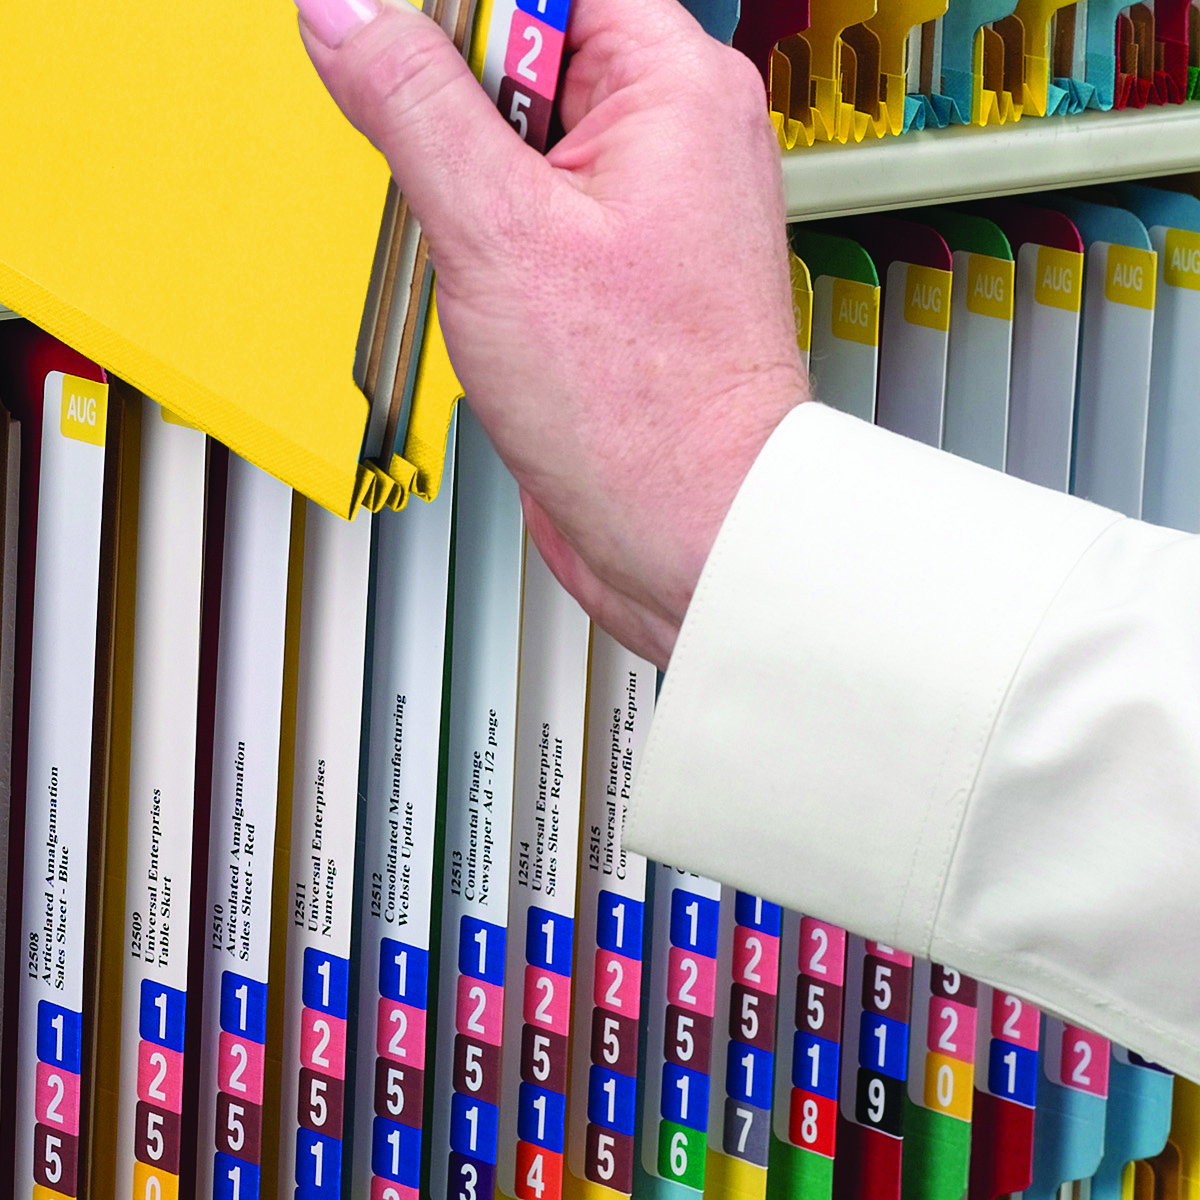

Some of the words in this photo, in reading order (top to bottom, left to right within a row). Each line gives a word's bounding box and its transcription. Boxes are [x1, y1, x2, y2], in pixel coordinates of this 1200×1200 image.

[911, 285, 942, 313] AUG
[973, 273, 1005, 303] AUG
[1042, 265, 1073, 295] AUG
[839, 298, 869, 327] AUG
[388, 693, 407, 816] Manufacturing
[535, 722, 552, 814] Enterprises
[549, 737, 565, 800] Reprint
[311, 758, 327, 852] Enterprises
[400, 800, 415, 860] Update
[547, 803, 560, 854] Sheet-
[147, 787, 163, 883] Enterprises
[531, 815, 546, 892] Universal
[383, 818, 400, 924] Consolidated
[517, 840, 531, 888] 12514
[544, 856, 558, 898] Sales
[159, 875, 173, 920] Skirt
[293, 881, 307, 929] 12511
[307, 854, 322, 933] Universal
[321, 858, 338, 939] Nametags
[369, 871, 383, 920] 12512
[397, 863, 412, 927] Website
[130, 910, 144, 960] 12509
[144, 885, 158, 965] Universal
[157, 922, 171, 969] Table
